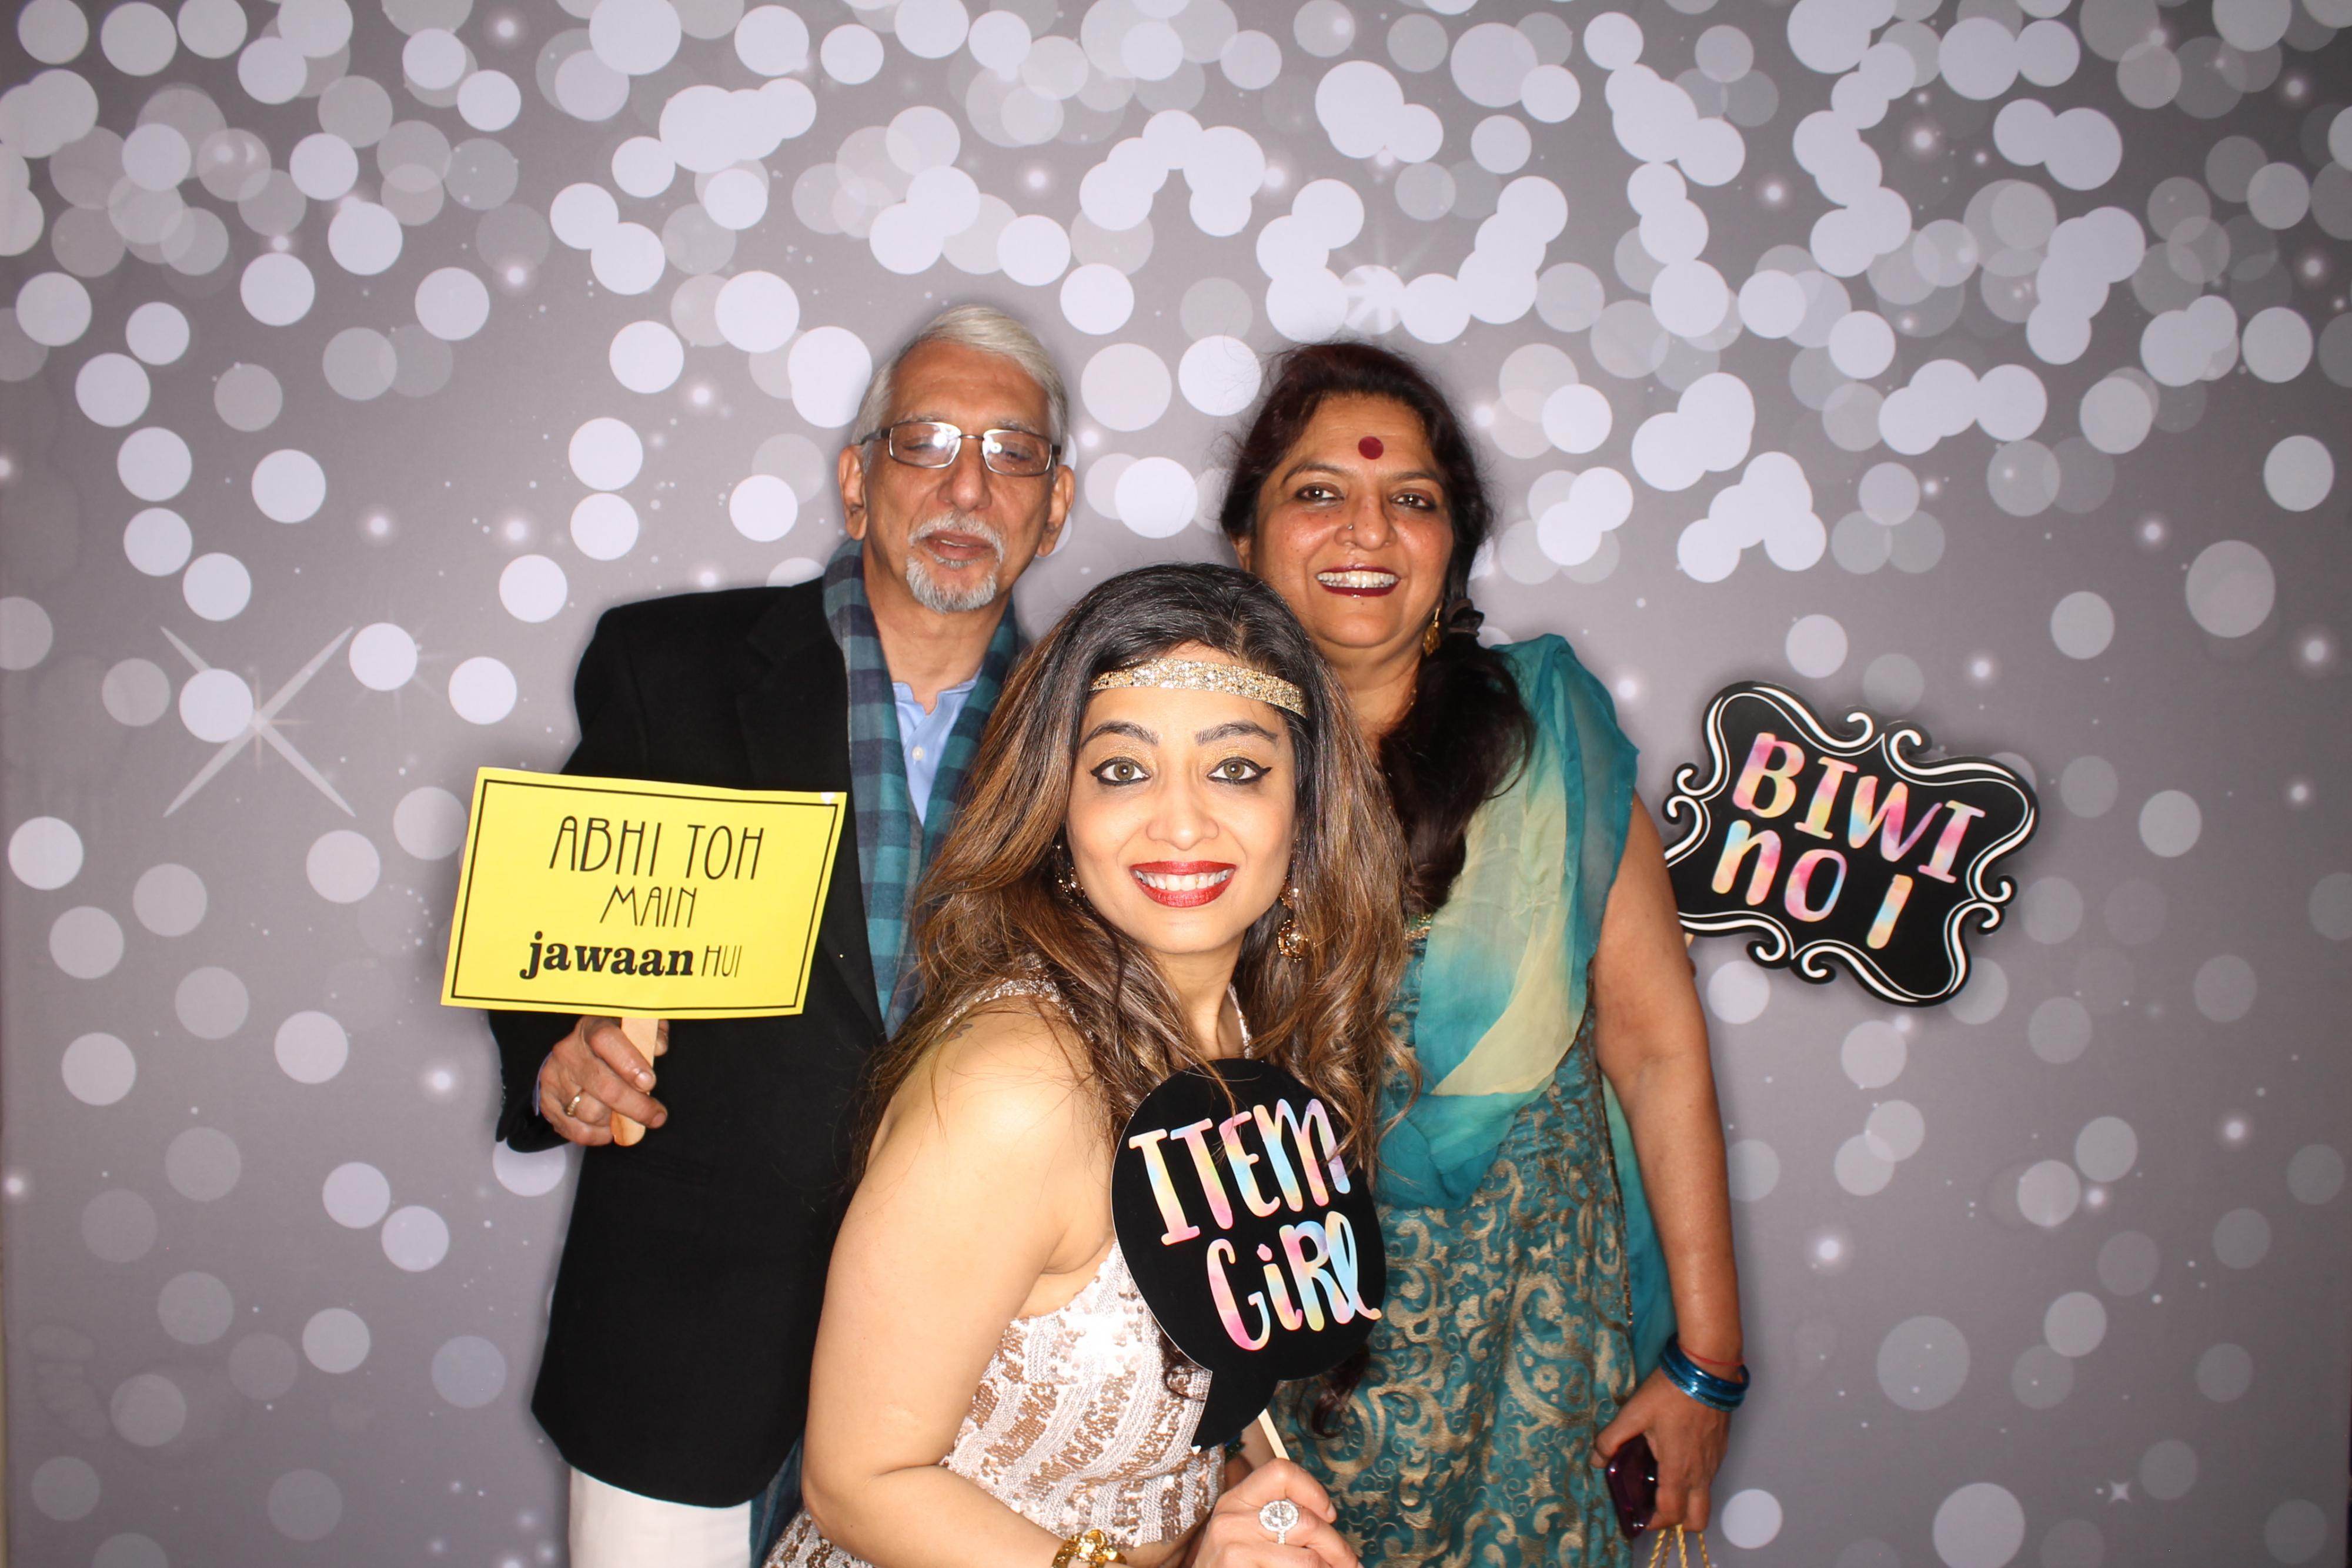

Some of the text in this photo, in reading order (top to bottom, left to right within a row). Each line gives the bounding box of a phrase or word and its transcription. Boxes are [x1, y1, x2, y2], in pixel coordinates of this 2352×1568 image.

[1732, 732, 1985, 883] BIWI
[549, 815, 764, 880] ABHI TOH
[600, 885, 697, 928] MAIN
[519, 931, 742, 979] jawaan HUI
